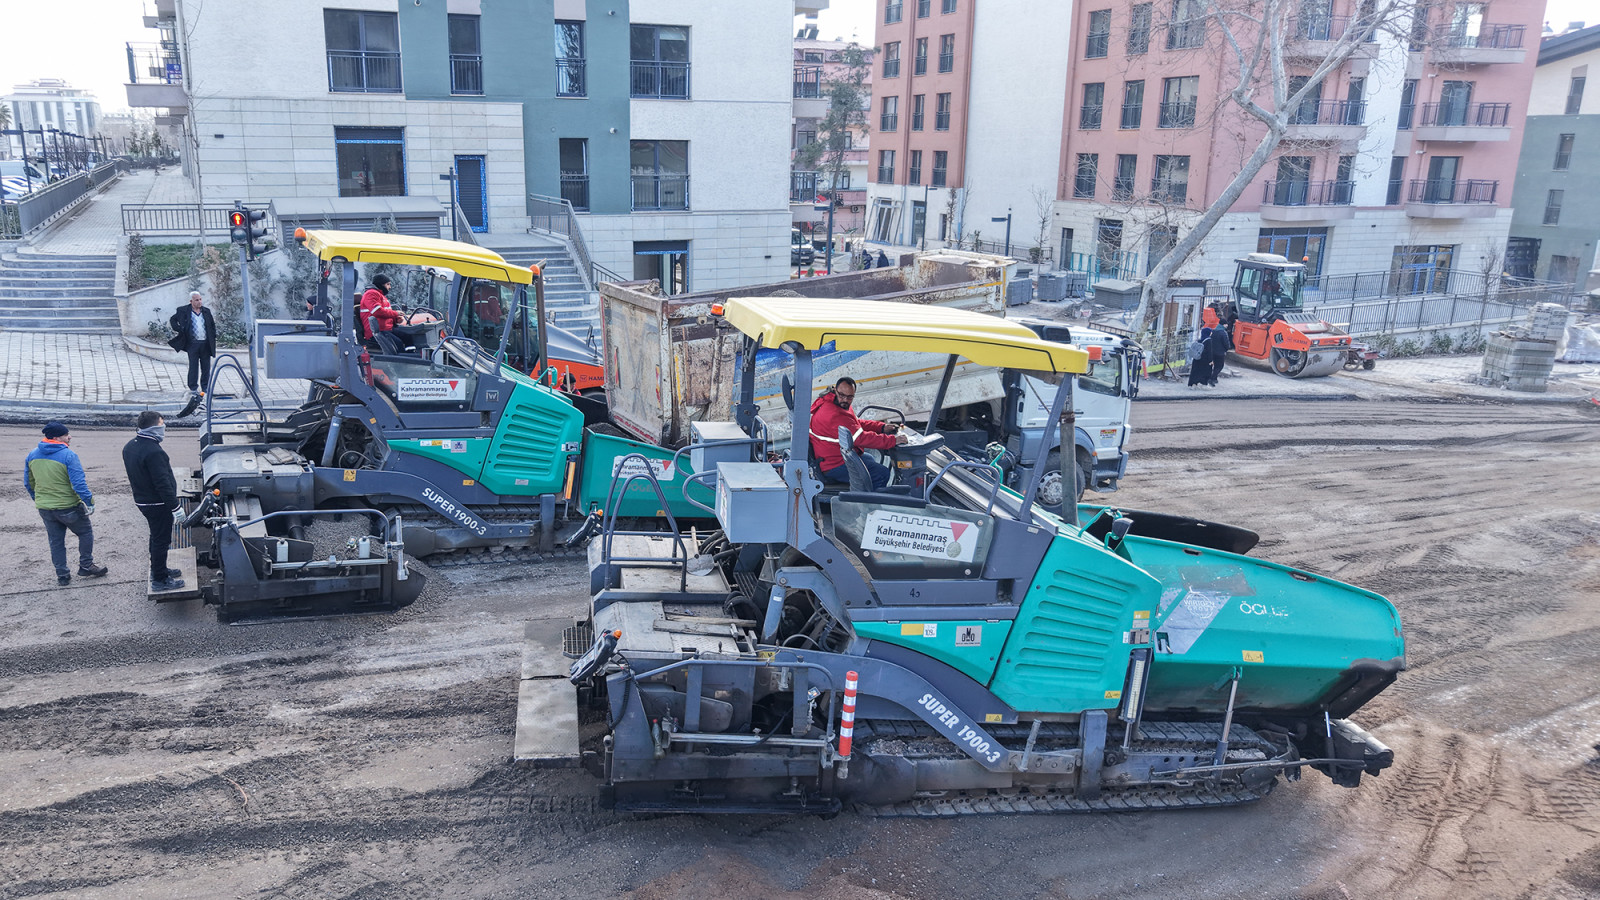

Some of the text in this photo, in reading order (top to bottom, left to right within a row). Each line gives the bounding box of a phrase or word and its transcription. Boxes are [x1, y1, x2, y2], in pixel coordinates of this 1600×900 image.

[422, 487, 487, 535] SUPER 1900-3
[874, 536, 945, 554] Büyükşehir Belediyesi
[876, 525, 948, 545] Kahramanmaraş
[917, 693, 1001, 763] SUPER 1900-3
